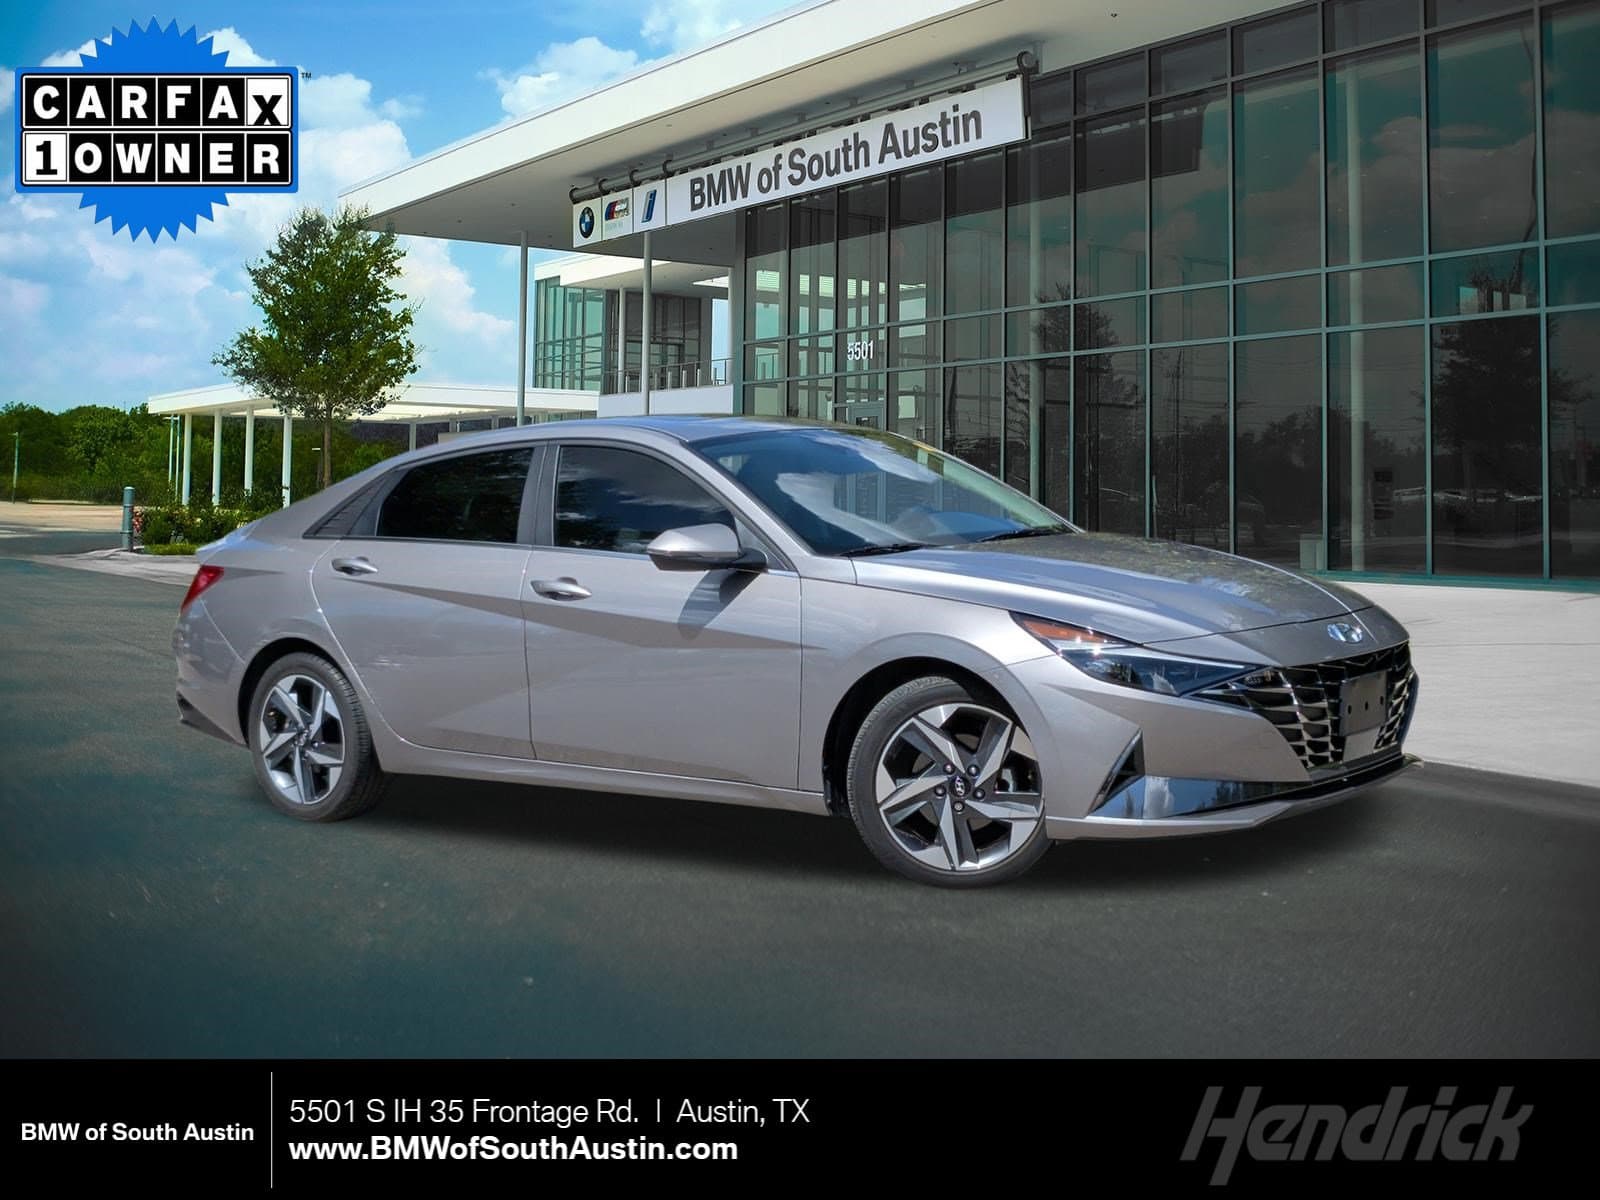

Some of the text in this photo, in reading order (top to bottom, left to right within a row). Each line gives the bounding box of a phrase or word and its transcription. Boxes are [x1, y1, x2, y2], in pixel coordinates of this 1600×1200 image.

[690, 163, 751, 211] BMW
[757, 153, 783, 194] of
[787, 132, 870, 186] South
[878, 104, 983, 164] Austin
[847, 340, 874, 360] 5501
